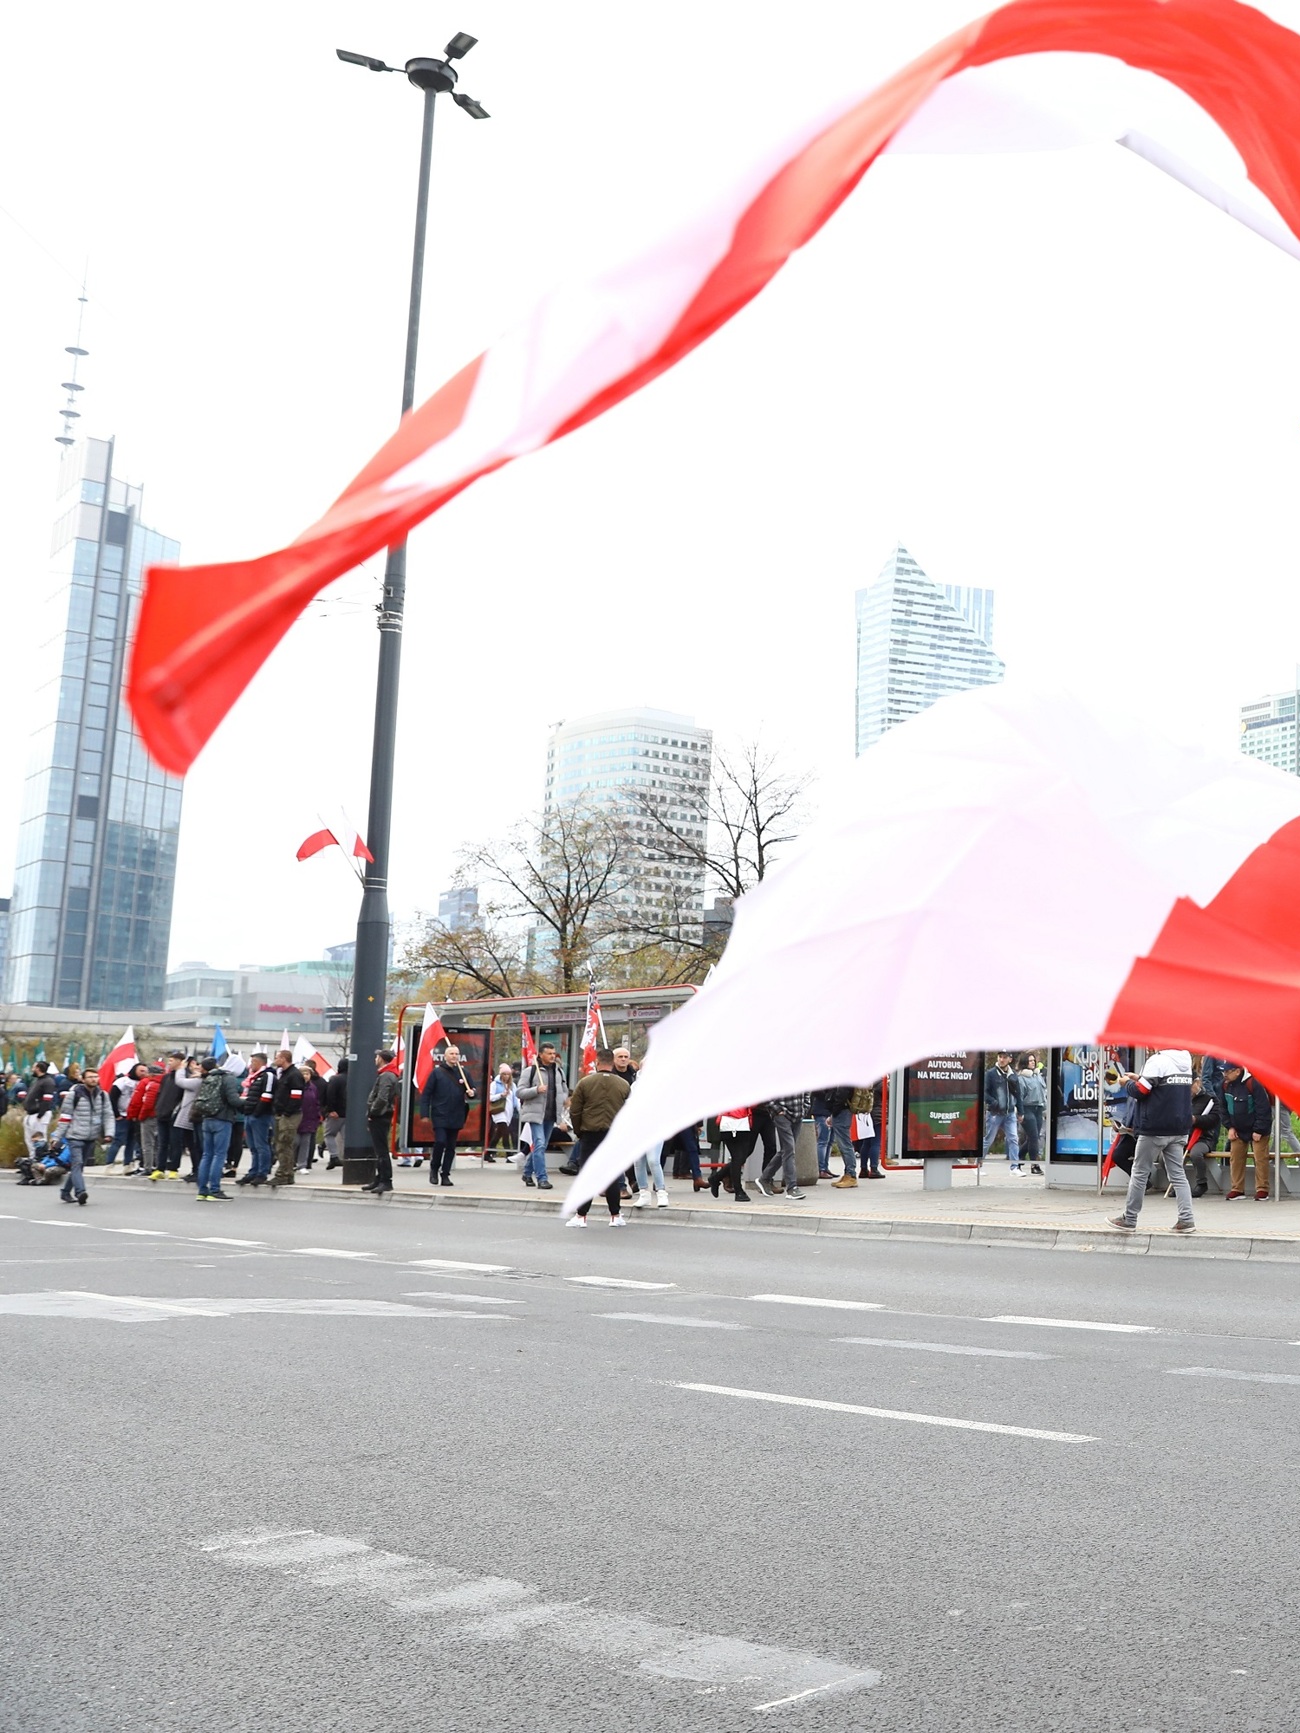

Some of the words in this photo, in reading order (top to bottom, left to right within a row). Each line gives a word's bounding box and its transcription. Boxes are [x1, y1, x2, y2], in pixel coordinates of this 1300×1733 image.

[927, 1060, 964, 1070] AUTOBUS,
[917, 1071, 928, 1079] NA
[930, 1071, 950, 1080] MECZ
[951, 1072, 973, 1080] NIGDY
[929, 1111, 960, 1119] SUPERBET
